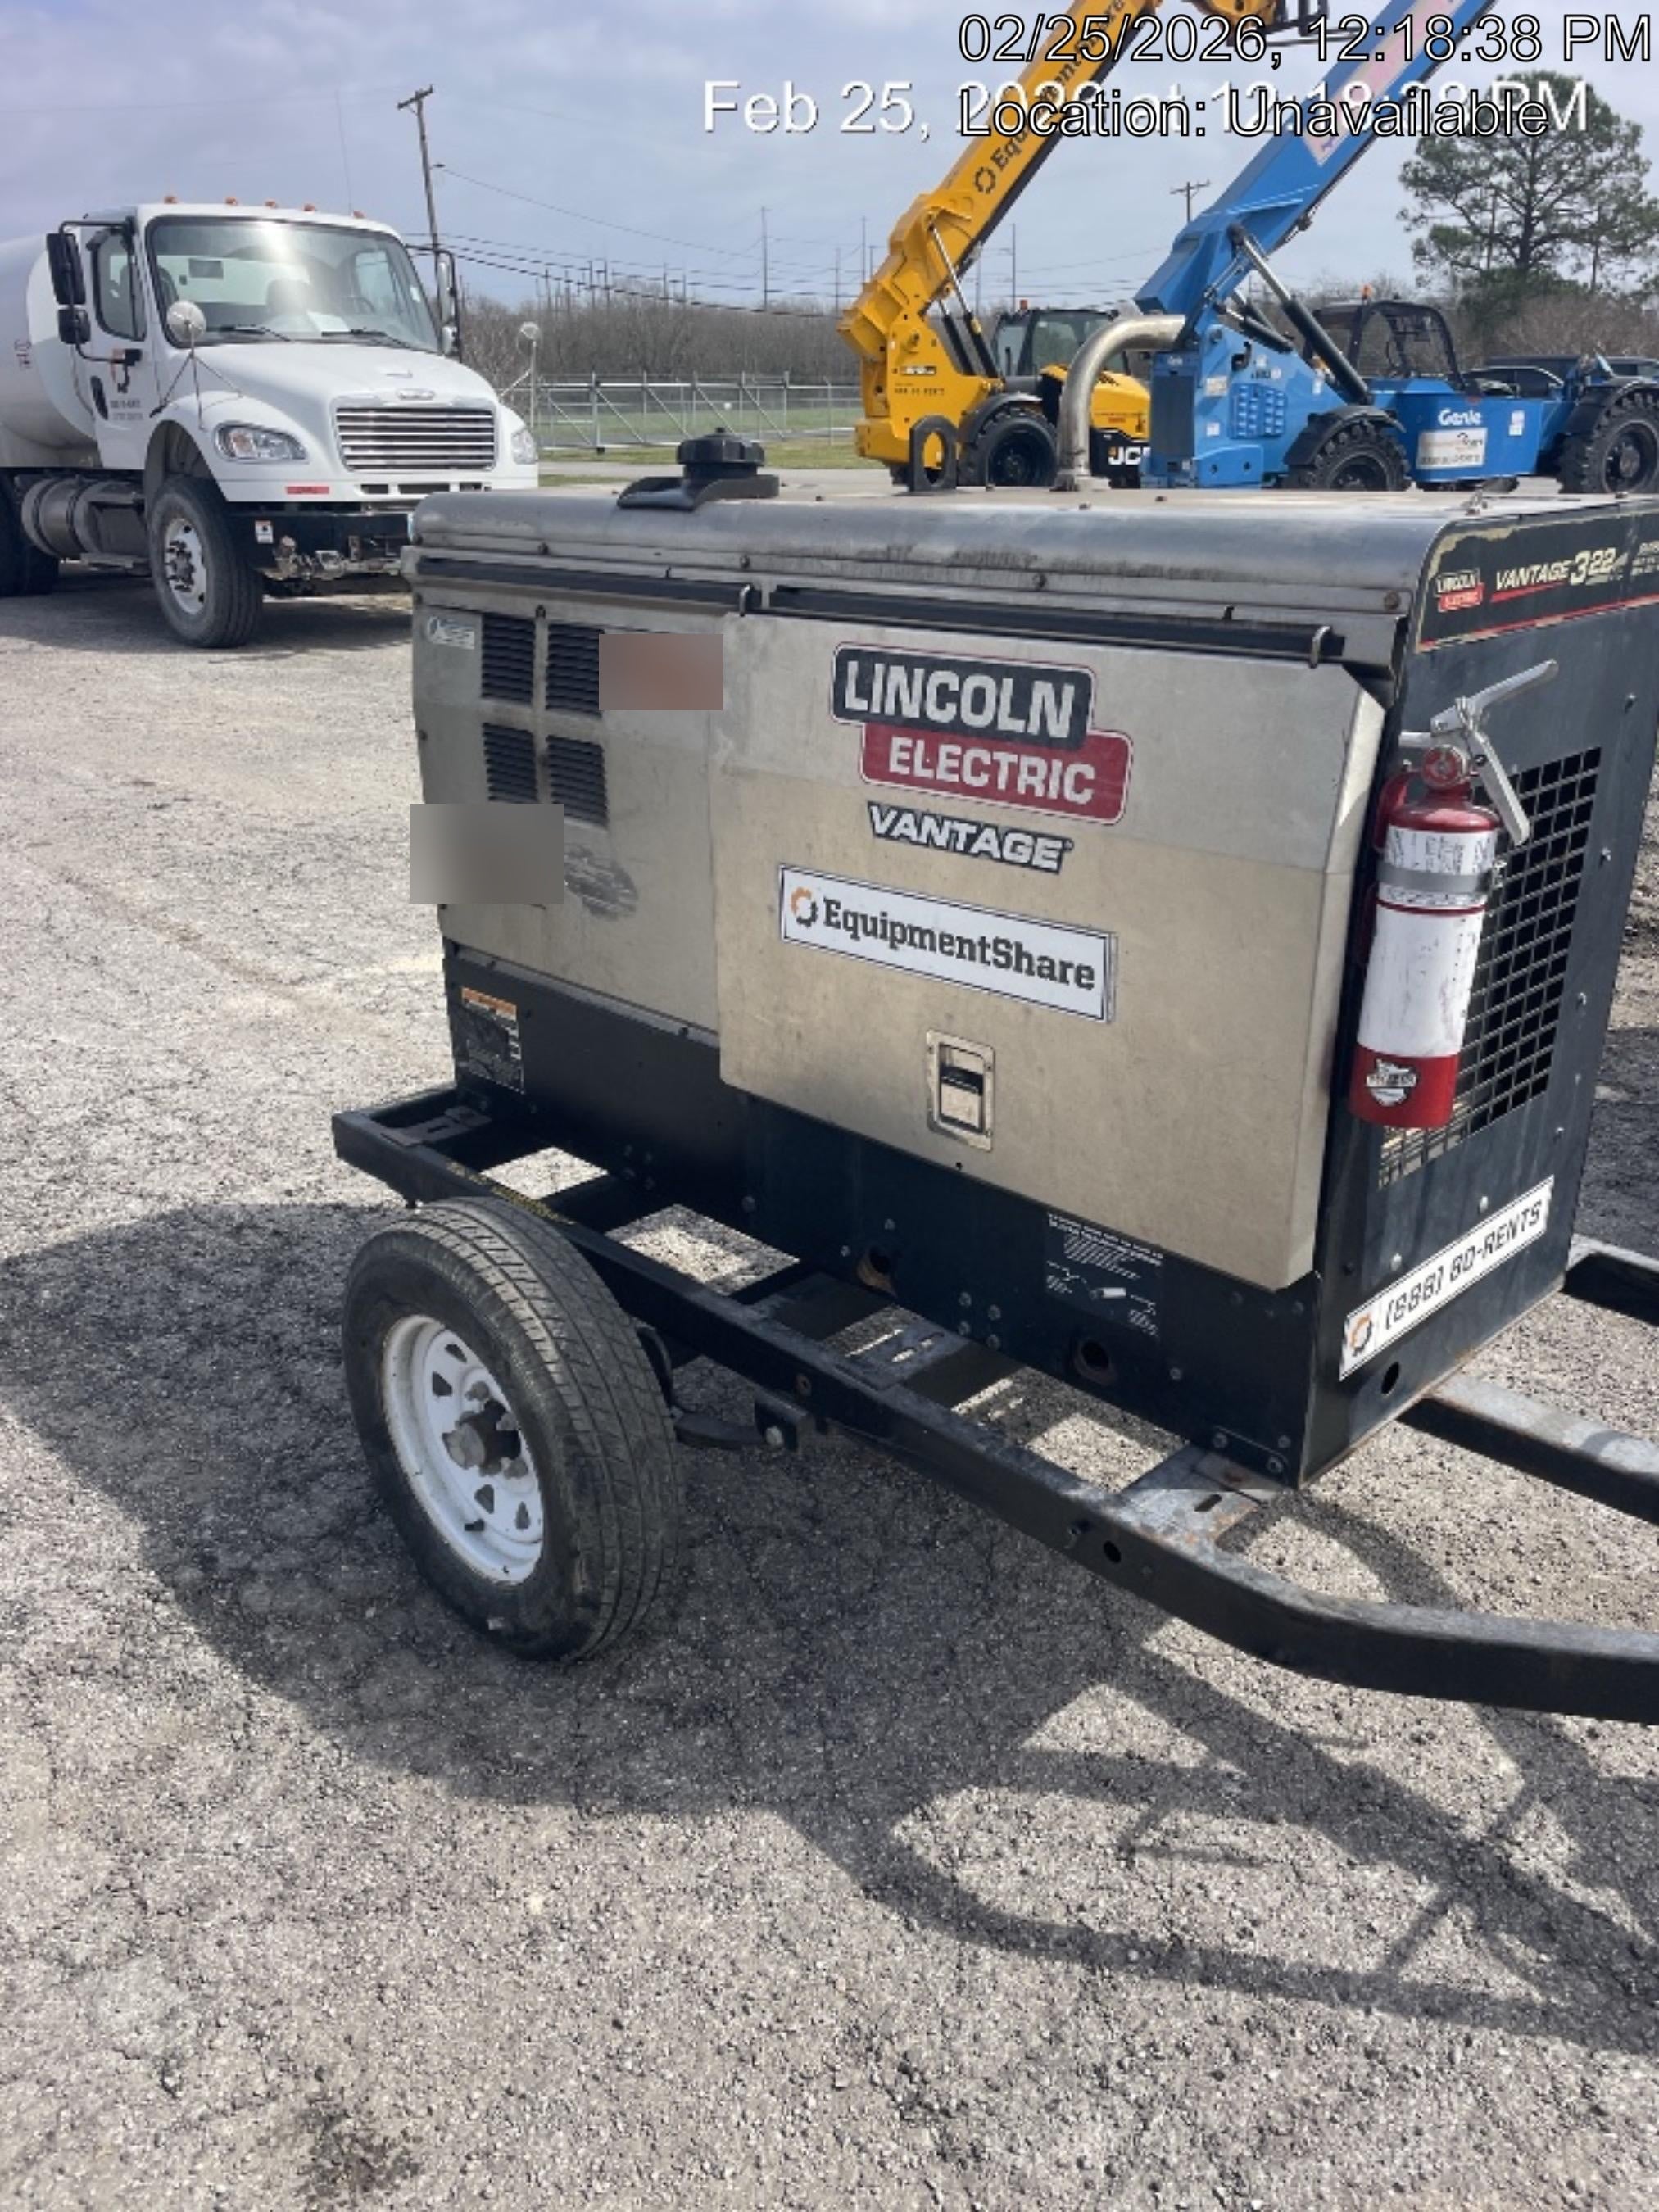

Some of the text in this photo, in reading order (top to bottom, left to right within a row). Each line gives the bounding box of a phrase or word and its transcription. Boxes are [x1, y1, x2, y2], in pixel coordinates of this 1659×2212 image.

[1496, 559, 1571, 590] VANTAGE
[1571, 547, 1616, 585] 322
[845, 660, 1075, 737] LINCOLN
[889, 736, 1096, 805] ELECTRIC
[870, 804, 1063, 871] VANTAGE
[823, 895, 1095, 991] EquipmentShare
[1385, 1266, 1444, 1330] (888)
